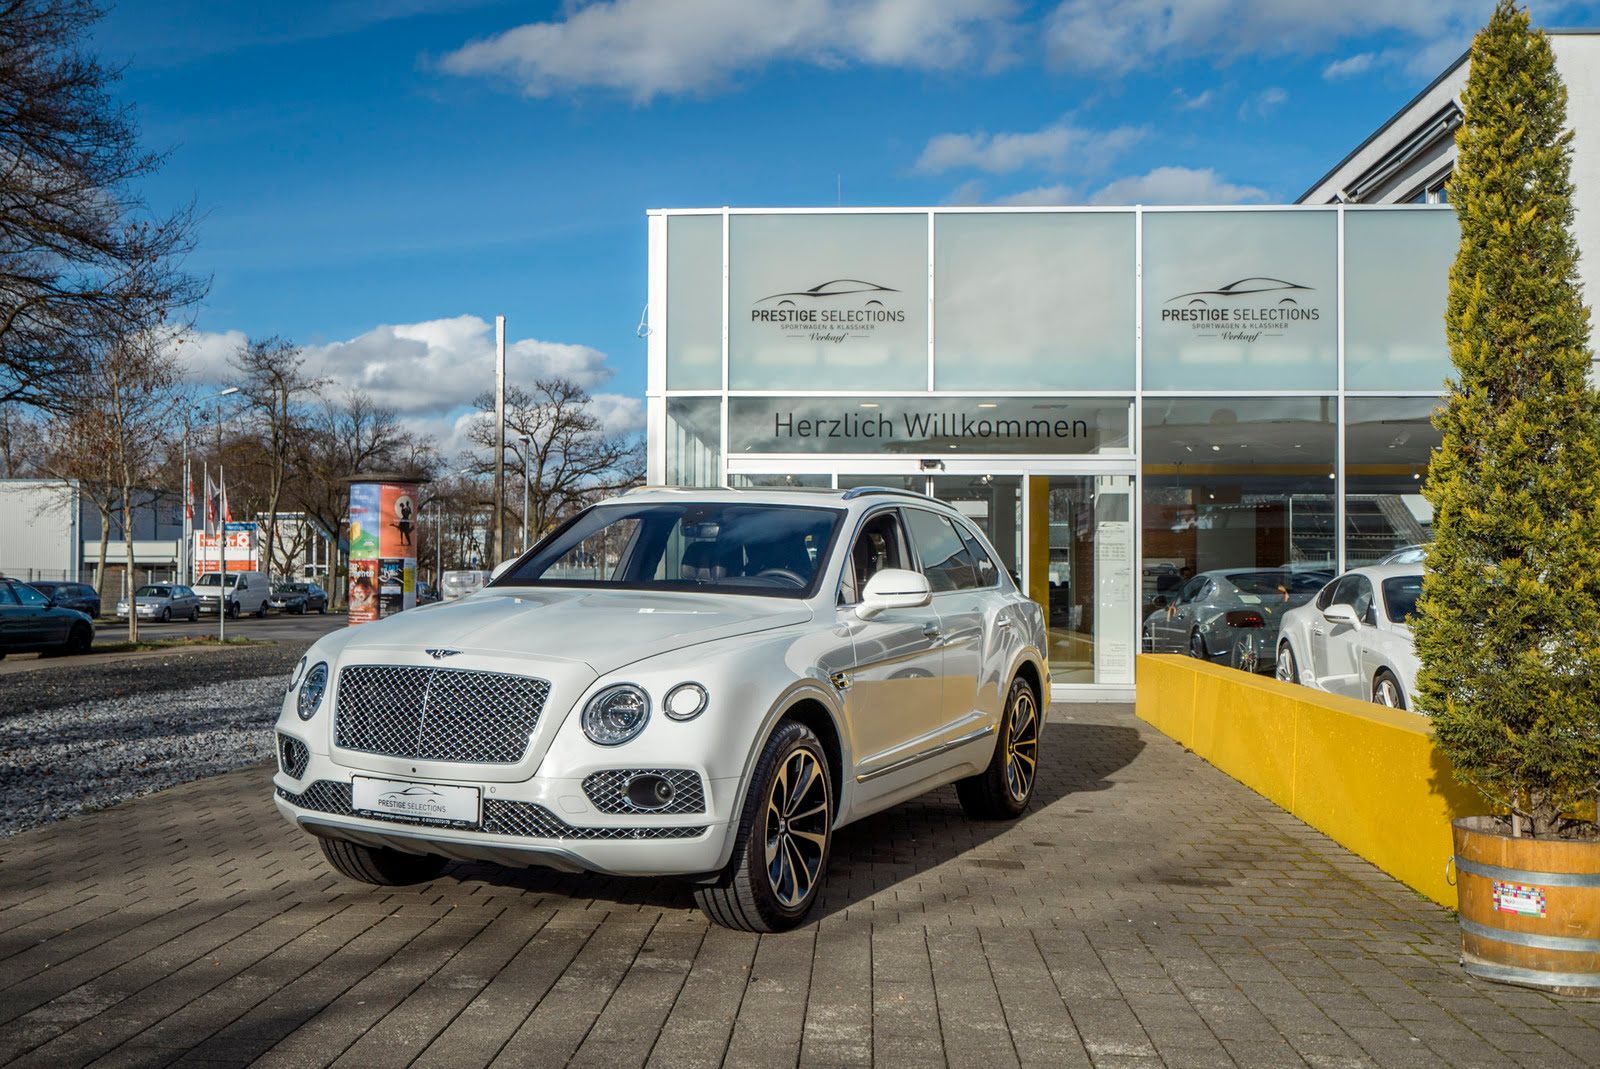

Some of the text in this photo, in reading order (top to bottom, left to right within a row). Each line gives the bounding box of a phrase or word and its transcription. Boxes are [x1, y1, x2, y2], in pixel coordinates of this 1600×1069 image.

[751, 309, 905, 322] PRESTIGE SELECTIONS
[1162, 308, 1320, 321] PRESTIGE SELECTIONS
[809, 332, 849, 343] Verkauf
[1221, 331, 1262, 342] Verkauf
[774, 412, 1088, 438] Herzlich Willkommen
[378, 799, 406, 809] PRESTIGE
[407, 802, 447, 813] SELECTIONS
